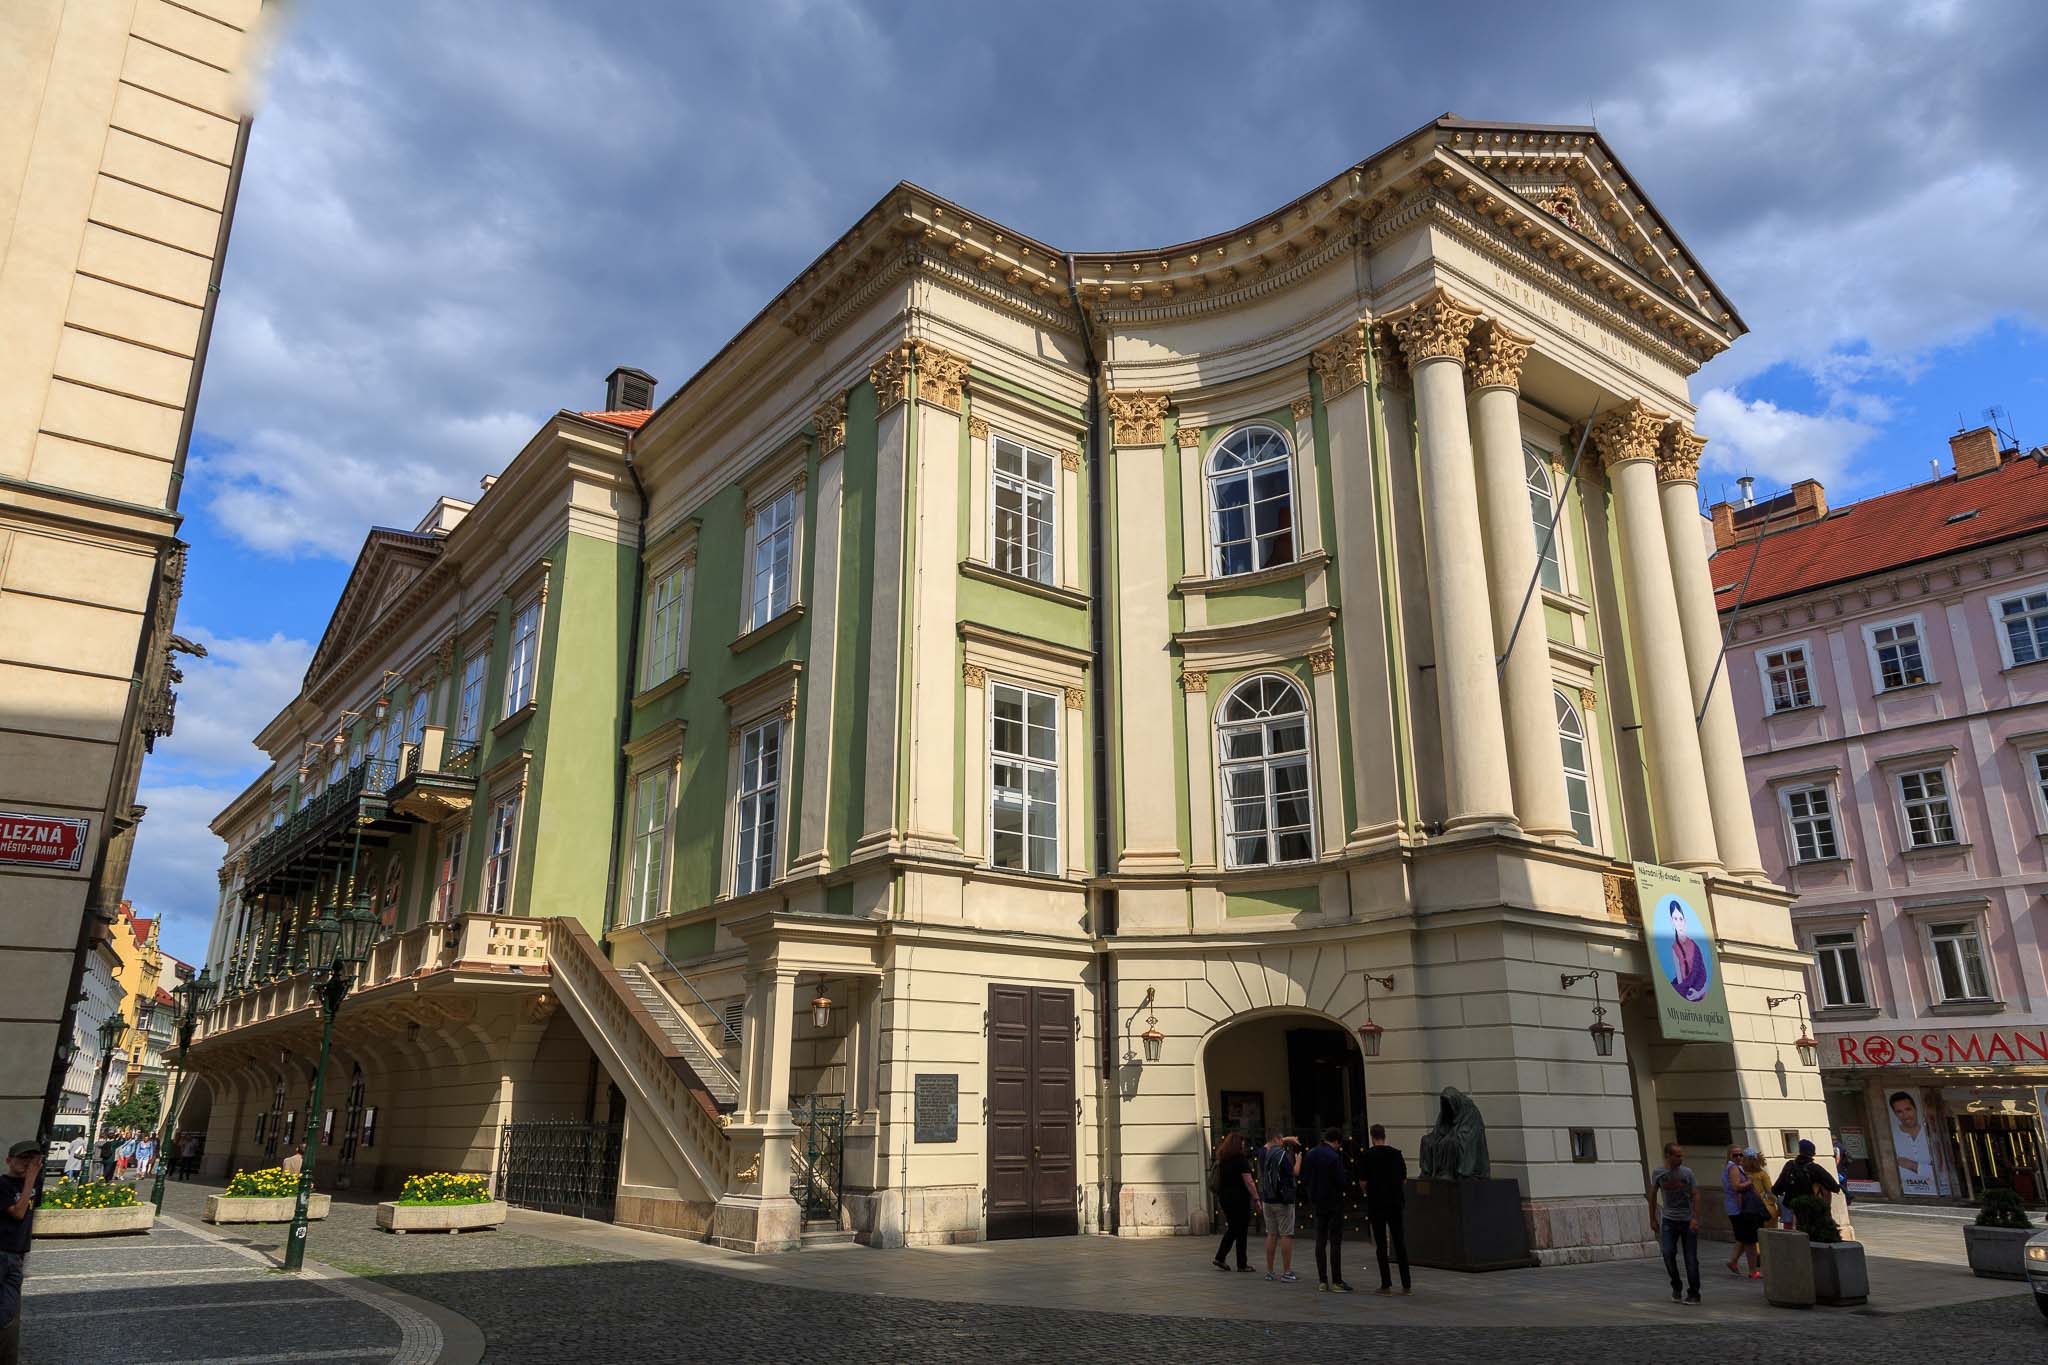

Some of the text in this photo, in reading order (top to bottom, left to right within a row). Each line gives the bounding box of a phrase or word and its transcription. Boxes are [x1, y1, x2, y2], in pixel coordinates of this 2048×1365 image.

[1495, 272, 1640, 370] PATRIAE ET MUSIS
[0, 823, 62, 844] LEZNÁ
